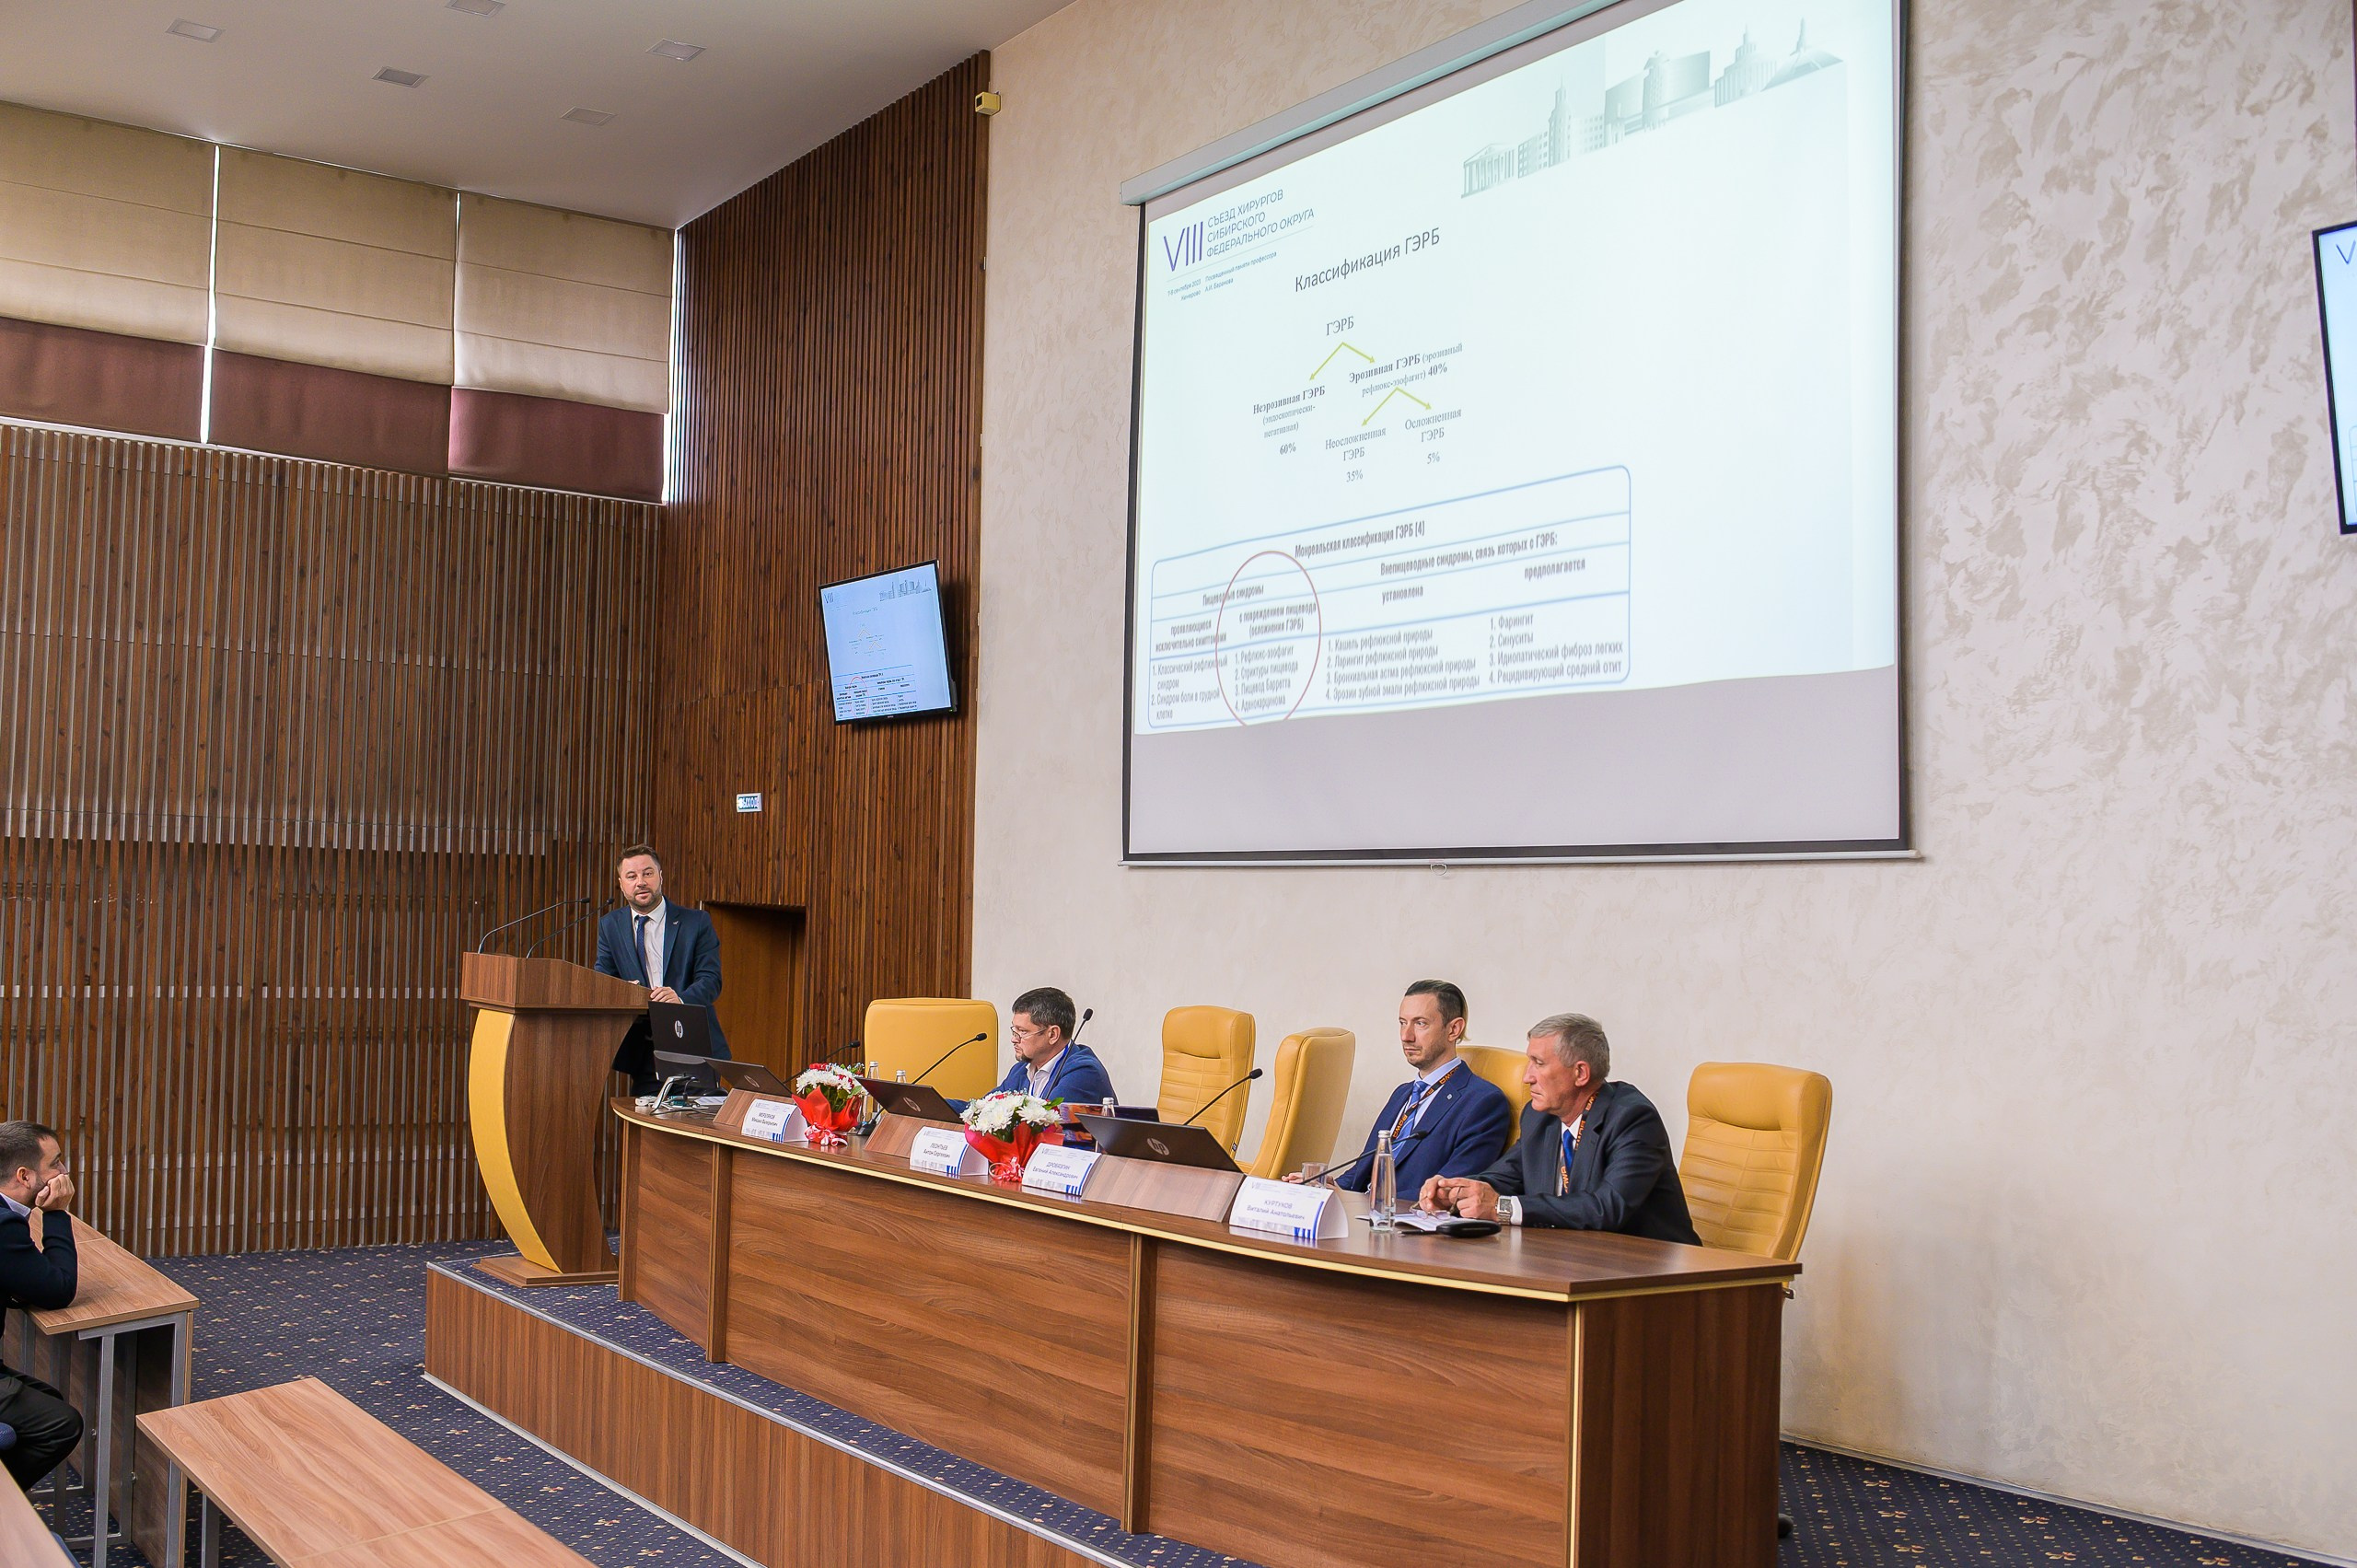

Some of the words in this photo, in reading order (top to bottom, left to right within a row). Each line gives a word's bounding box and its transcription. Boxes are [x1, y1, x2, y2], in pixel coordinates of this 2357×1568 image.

[1208, 209, 1235, 228] СЪЕЗД
[1237, 189, 1284, 216] ХИРУРГОВ
[1207, 212, 1266, 243] СИБИРСКОГО
[1207, 220, 1277, 258] ФЕДЕРАЛЬНОГО
[1279, 208, 1315, 230] ОКРУГА
[1163, 221, 1203, 272] VIII
[1295, 243, 1400, 292] Классификация
[1405, 227, 1441, 255] ГЭРБ
[1326, 316, 1354, 337] ГЭРБ
[1349, 363, 1393, 384] Эрозивная
[1396, 354, 1421, 372] ГЭРБ
[1422, 343, 1463, 365] (эрозивный
[1362, 371, 1427, 398] рефлюкс-эзофагит)
[1428, 363, 1448, 377] 40%
[1253, 392, 1301, 415] Неэрозивная
[1302, 385, 1325, 401] ГЭРБ
[1264, 421, 1299, 439] негативная)
[1405, 408, 1462, 431] Осложненная
[1325, 426, 1387, 451] Неосложненная
[1421, 426, 1445, 444] ГЭРБ
[1280, 442, 1296, 456] 60%
[1343, 447, 1365, 462] ГЭРБ
[1427, 452, 1440, 465] 5%
[1346, 469, 1364, 483] 35%
[1295, 540, 1341, 559] Монреальская
[1342, 529, 1394, 553] классификация
[1395, 523, 1413, 540] ГЭРБ
[1475, 547, 1495, 560] связь
[1498, 540, 1527, 557] которых
[1536, 532, 1557, 549] ГЭРБ:
[1498, 614, 1533, 631] Фарингит
[1498, 633, 1534, 649] Синуситы
[1148, 1138, 1169, 1156] hp
